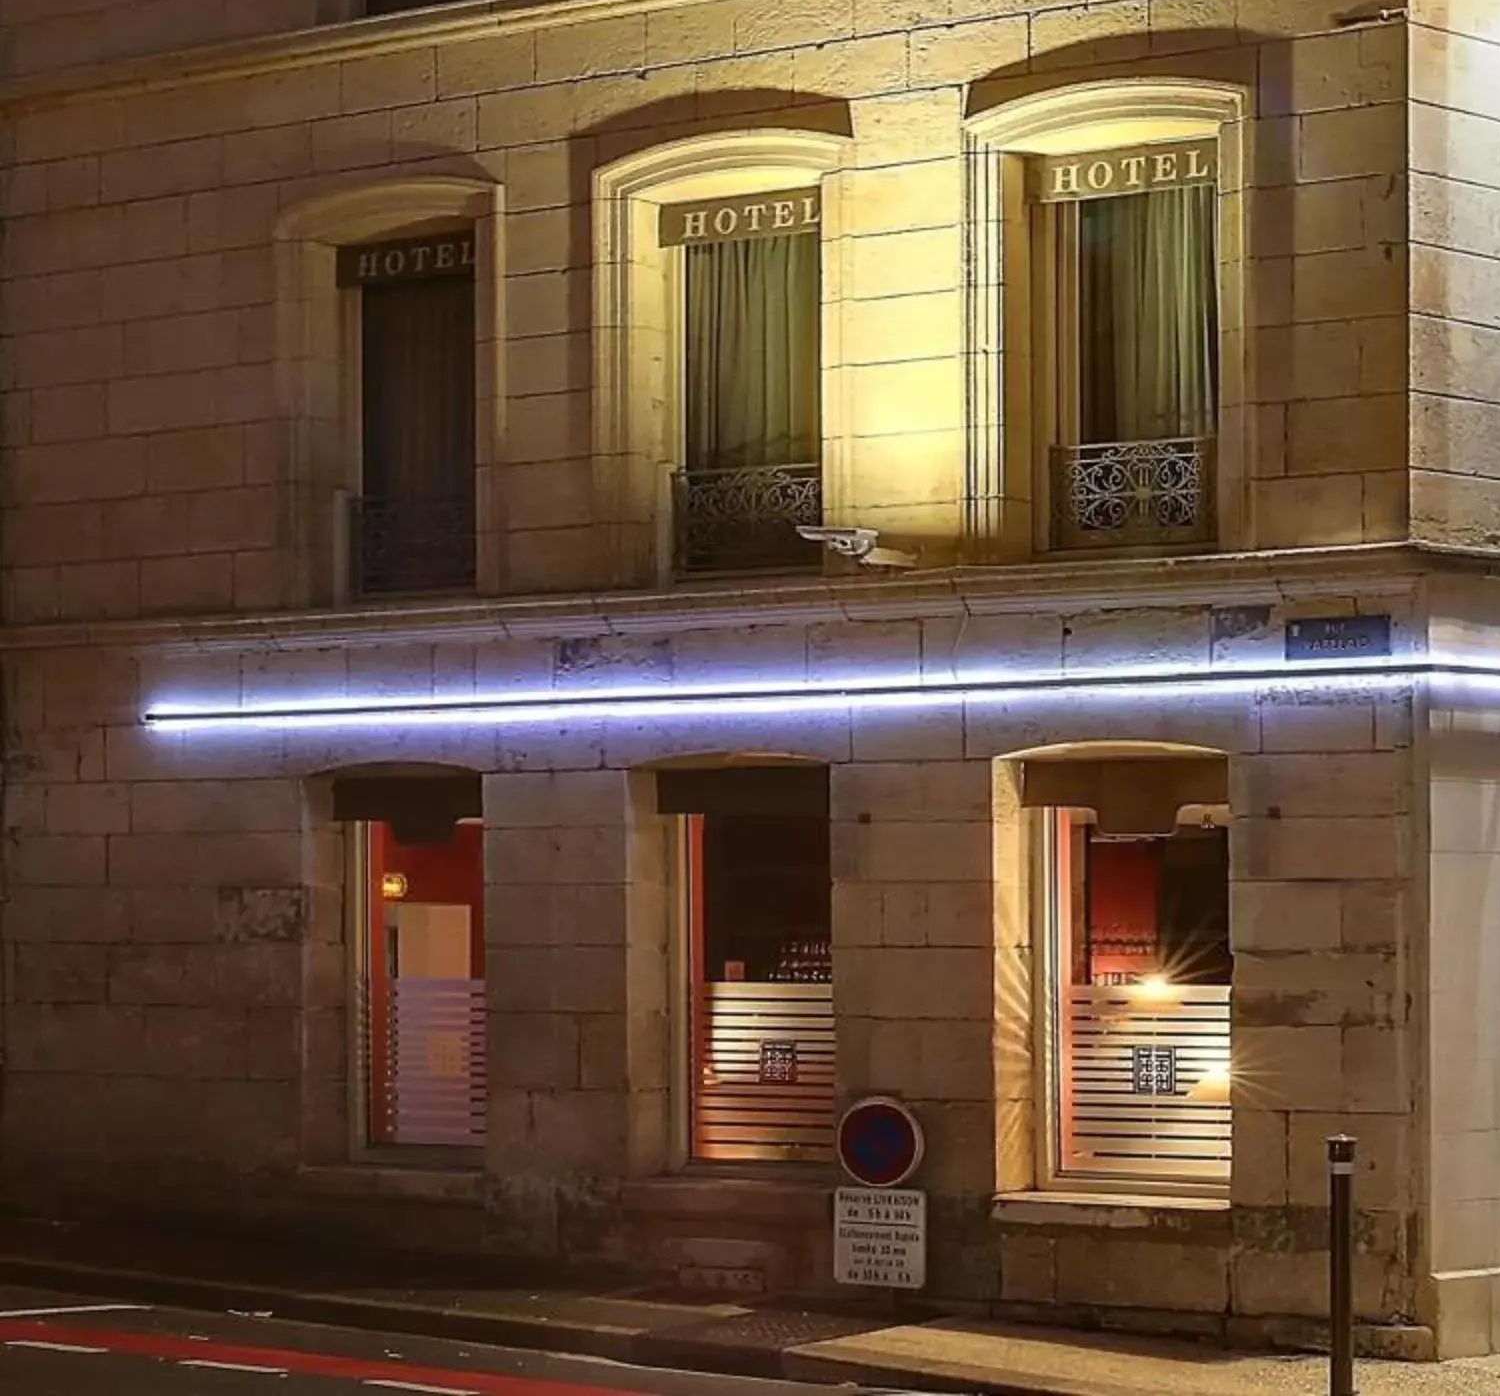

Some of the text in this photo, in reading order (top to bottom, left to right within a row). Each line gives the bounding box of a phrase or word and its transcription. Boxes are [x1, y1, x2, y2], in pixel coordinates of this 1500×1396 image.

[1052, 149, 1208, 193] HOTEL
[682, 197, 820, 239] HOTEL
[358, 241, 477, 278] HOTEL
